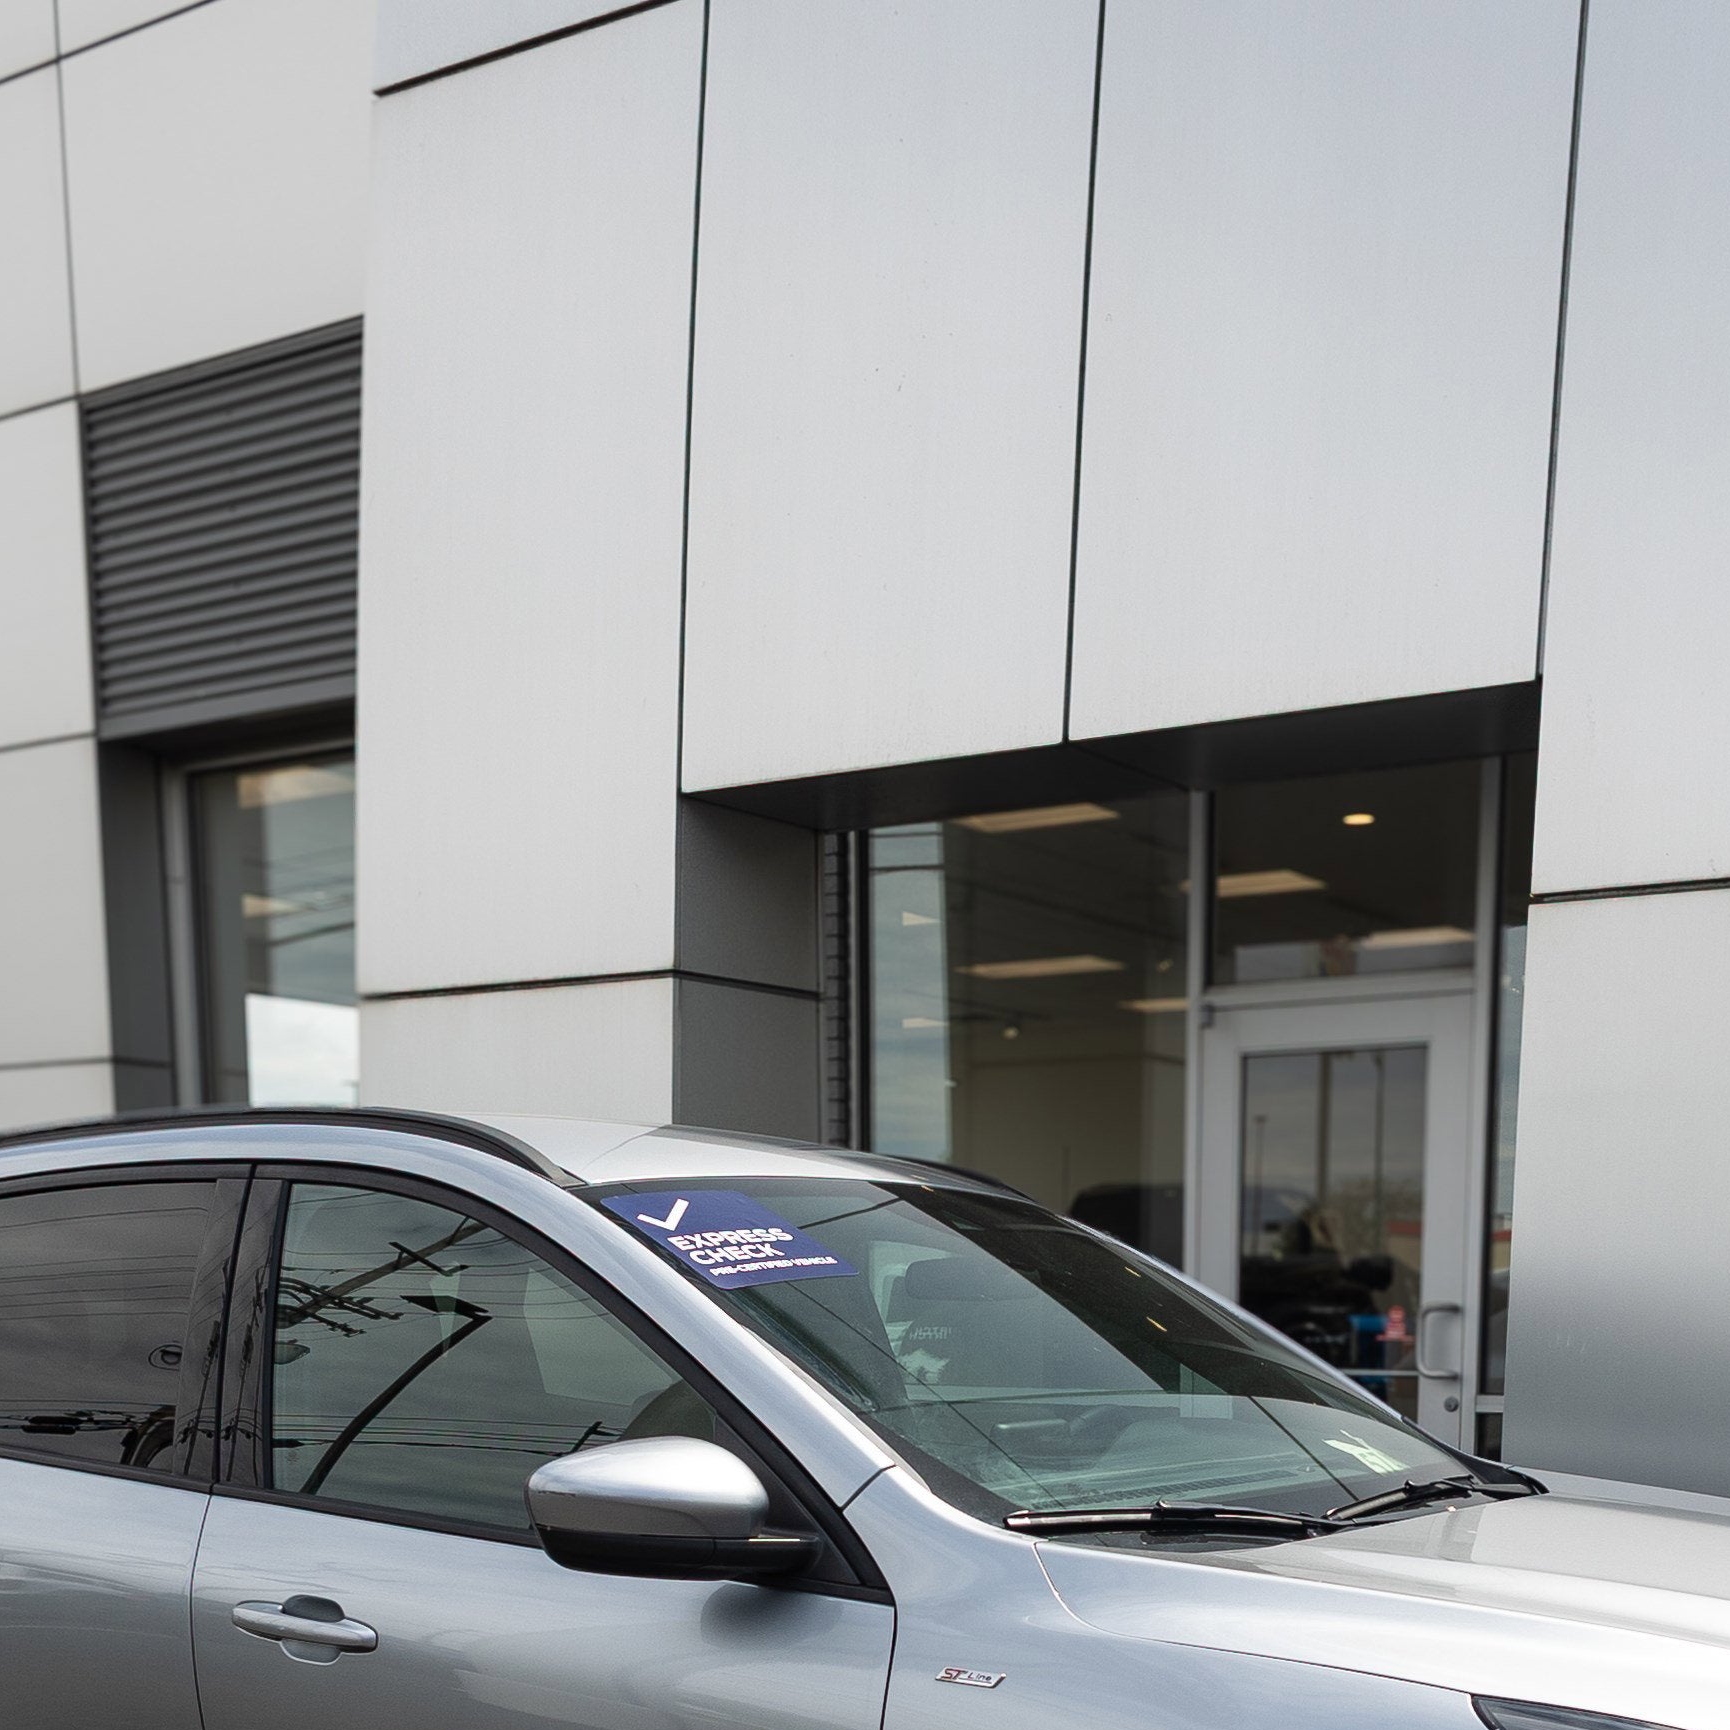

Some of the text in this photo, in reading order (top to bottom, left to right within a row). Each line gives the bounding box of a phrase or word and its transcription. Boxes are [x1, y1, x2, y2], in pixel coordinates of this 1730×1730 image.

[667, 1227, 794, 1251] EXPRESS
[689, 1243, 786, 1265] CHECK
[709, 1256, 838, 1277] PRE-CERTIFIED VEHICLE
[940, 1668, 992, 1681] ST Line
